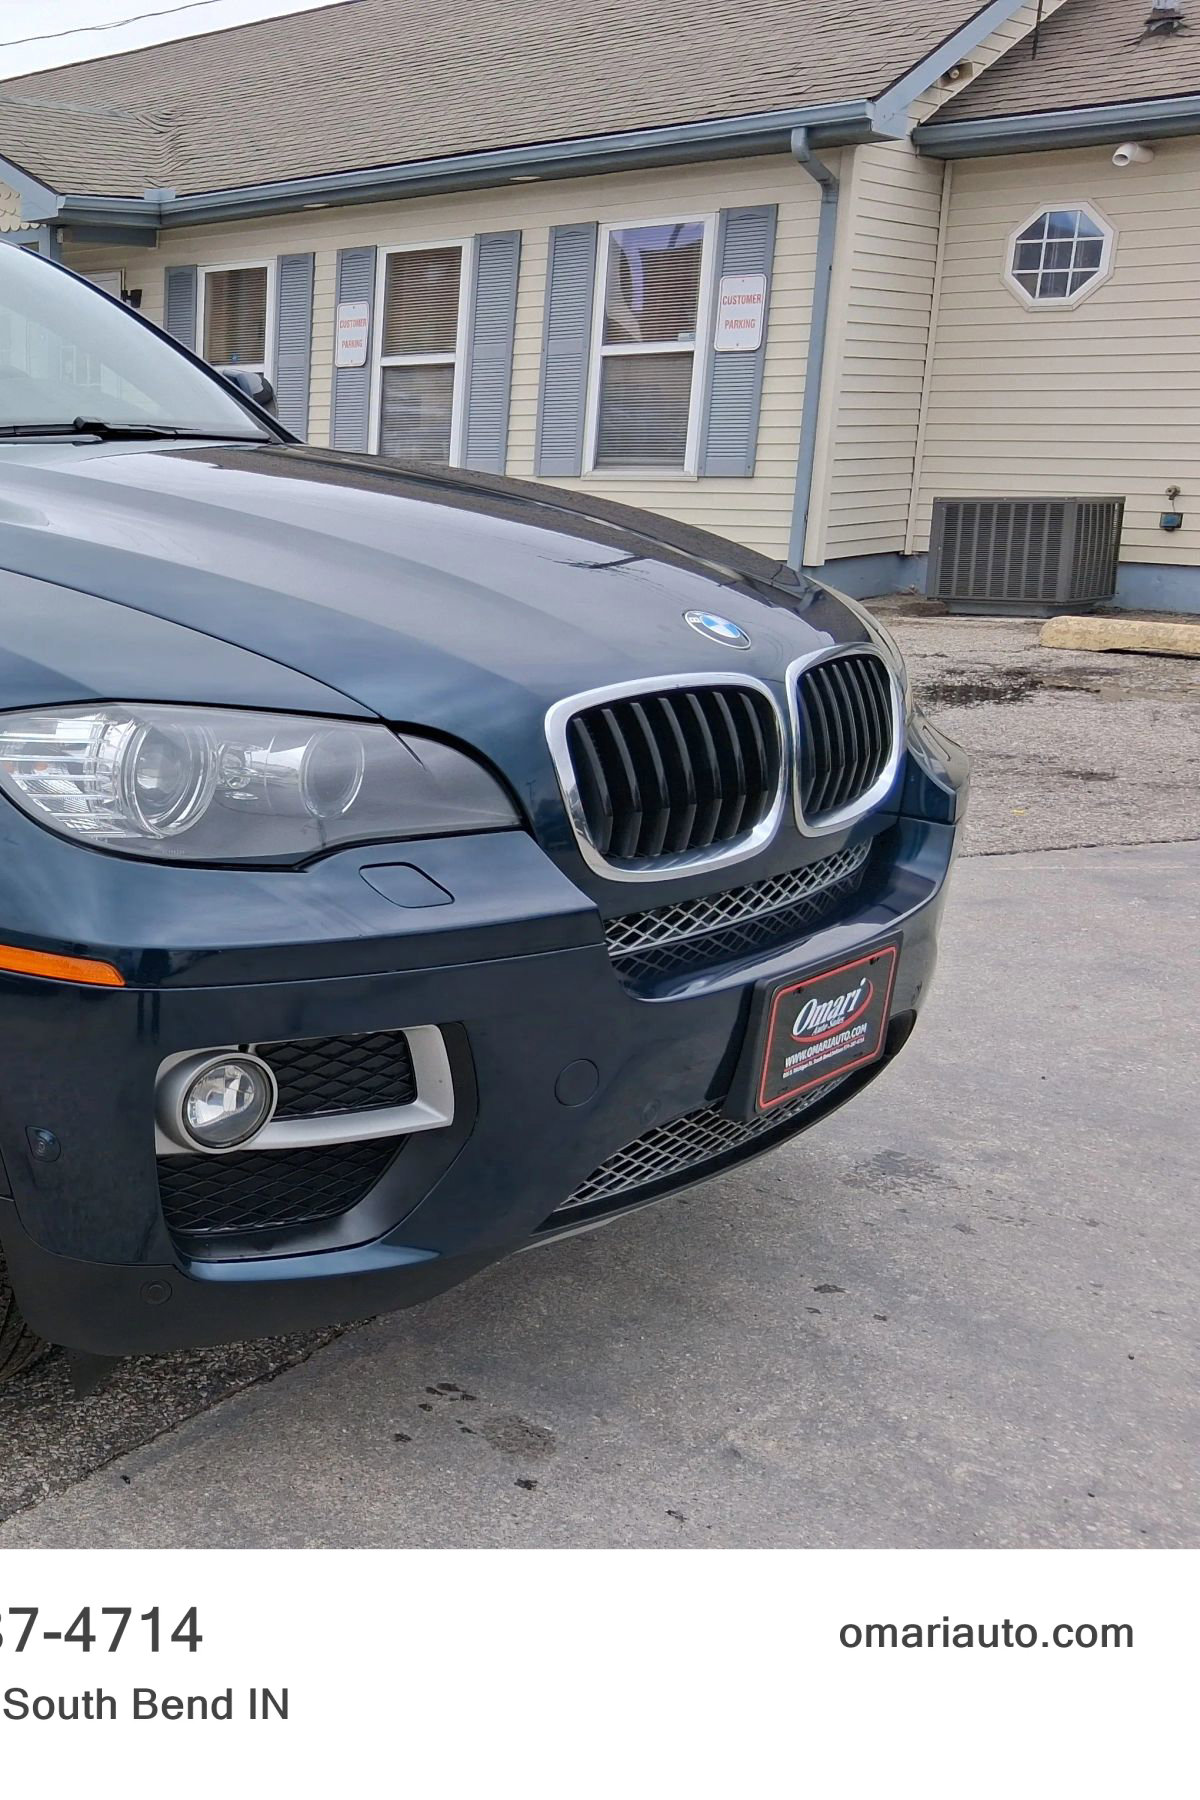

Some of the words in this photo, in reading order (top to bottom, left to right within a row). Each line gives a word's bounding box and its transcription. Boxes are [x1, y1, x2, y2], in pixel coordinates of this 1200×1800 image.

[721, 293, 763, 306] CUSTOMER
[339, 318, 368, 329] CUSTOMER
[724, 318, 757, 331] PARKING
[341, 339, 364, 349] PARKING
[792, 976, 867, 1037] Omari
